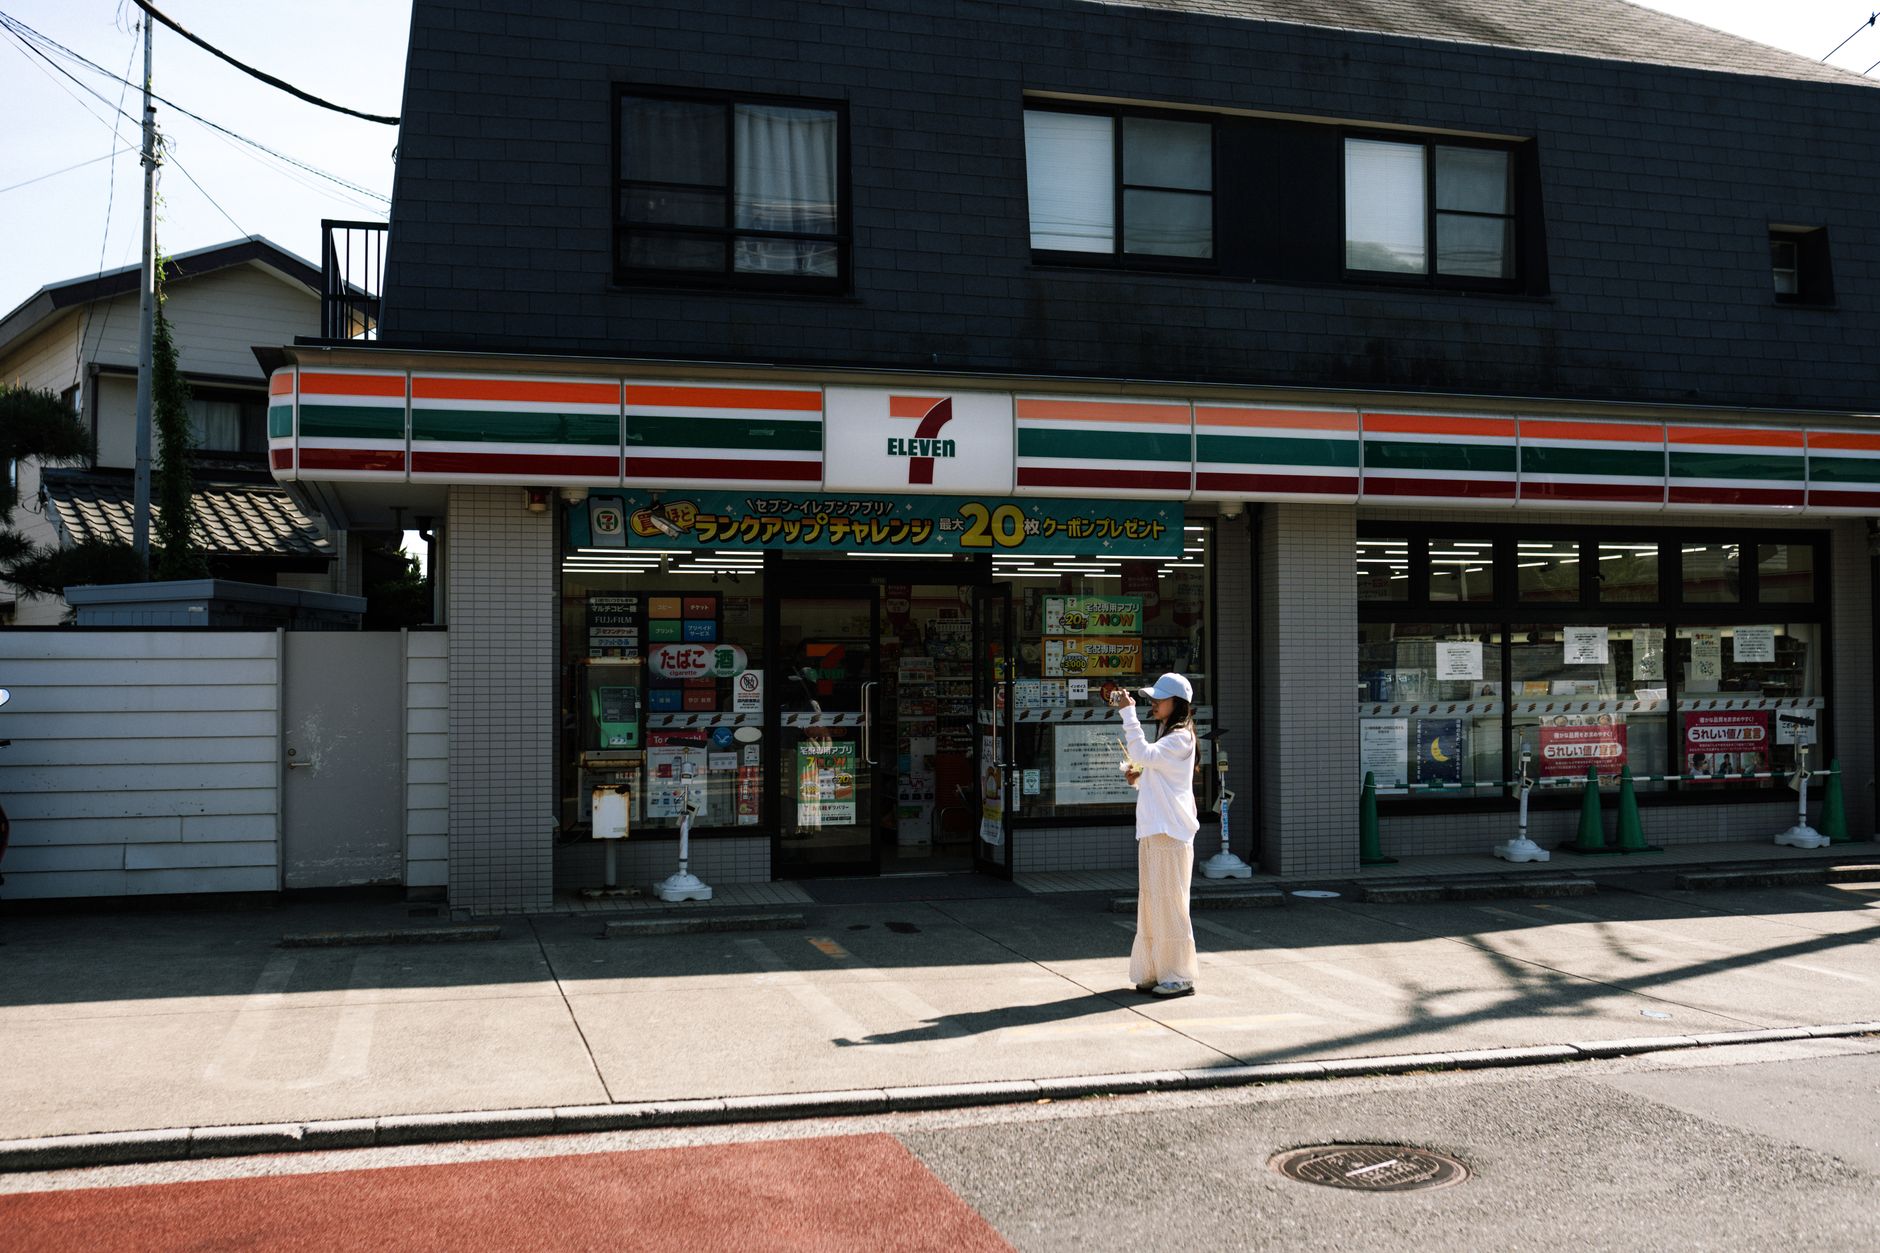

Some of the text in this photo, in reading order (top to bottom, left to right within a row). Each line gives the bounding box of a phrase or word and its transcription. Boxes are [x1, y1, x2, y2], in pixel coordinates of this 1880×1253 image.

[889, 395, 953, 484] 7
[637, 505, 692, 532] 買ほど
[695, 513, 933, 545] ランクアップチャレンジ
[1091, 613, 1134, 627] 7NOW
[660, 649, 734, 669] たばこ 酒
[1091, 655, 1134, 668] 7NOW
